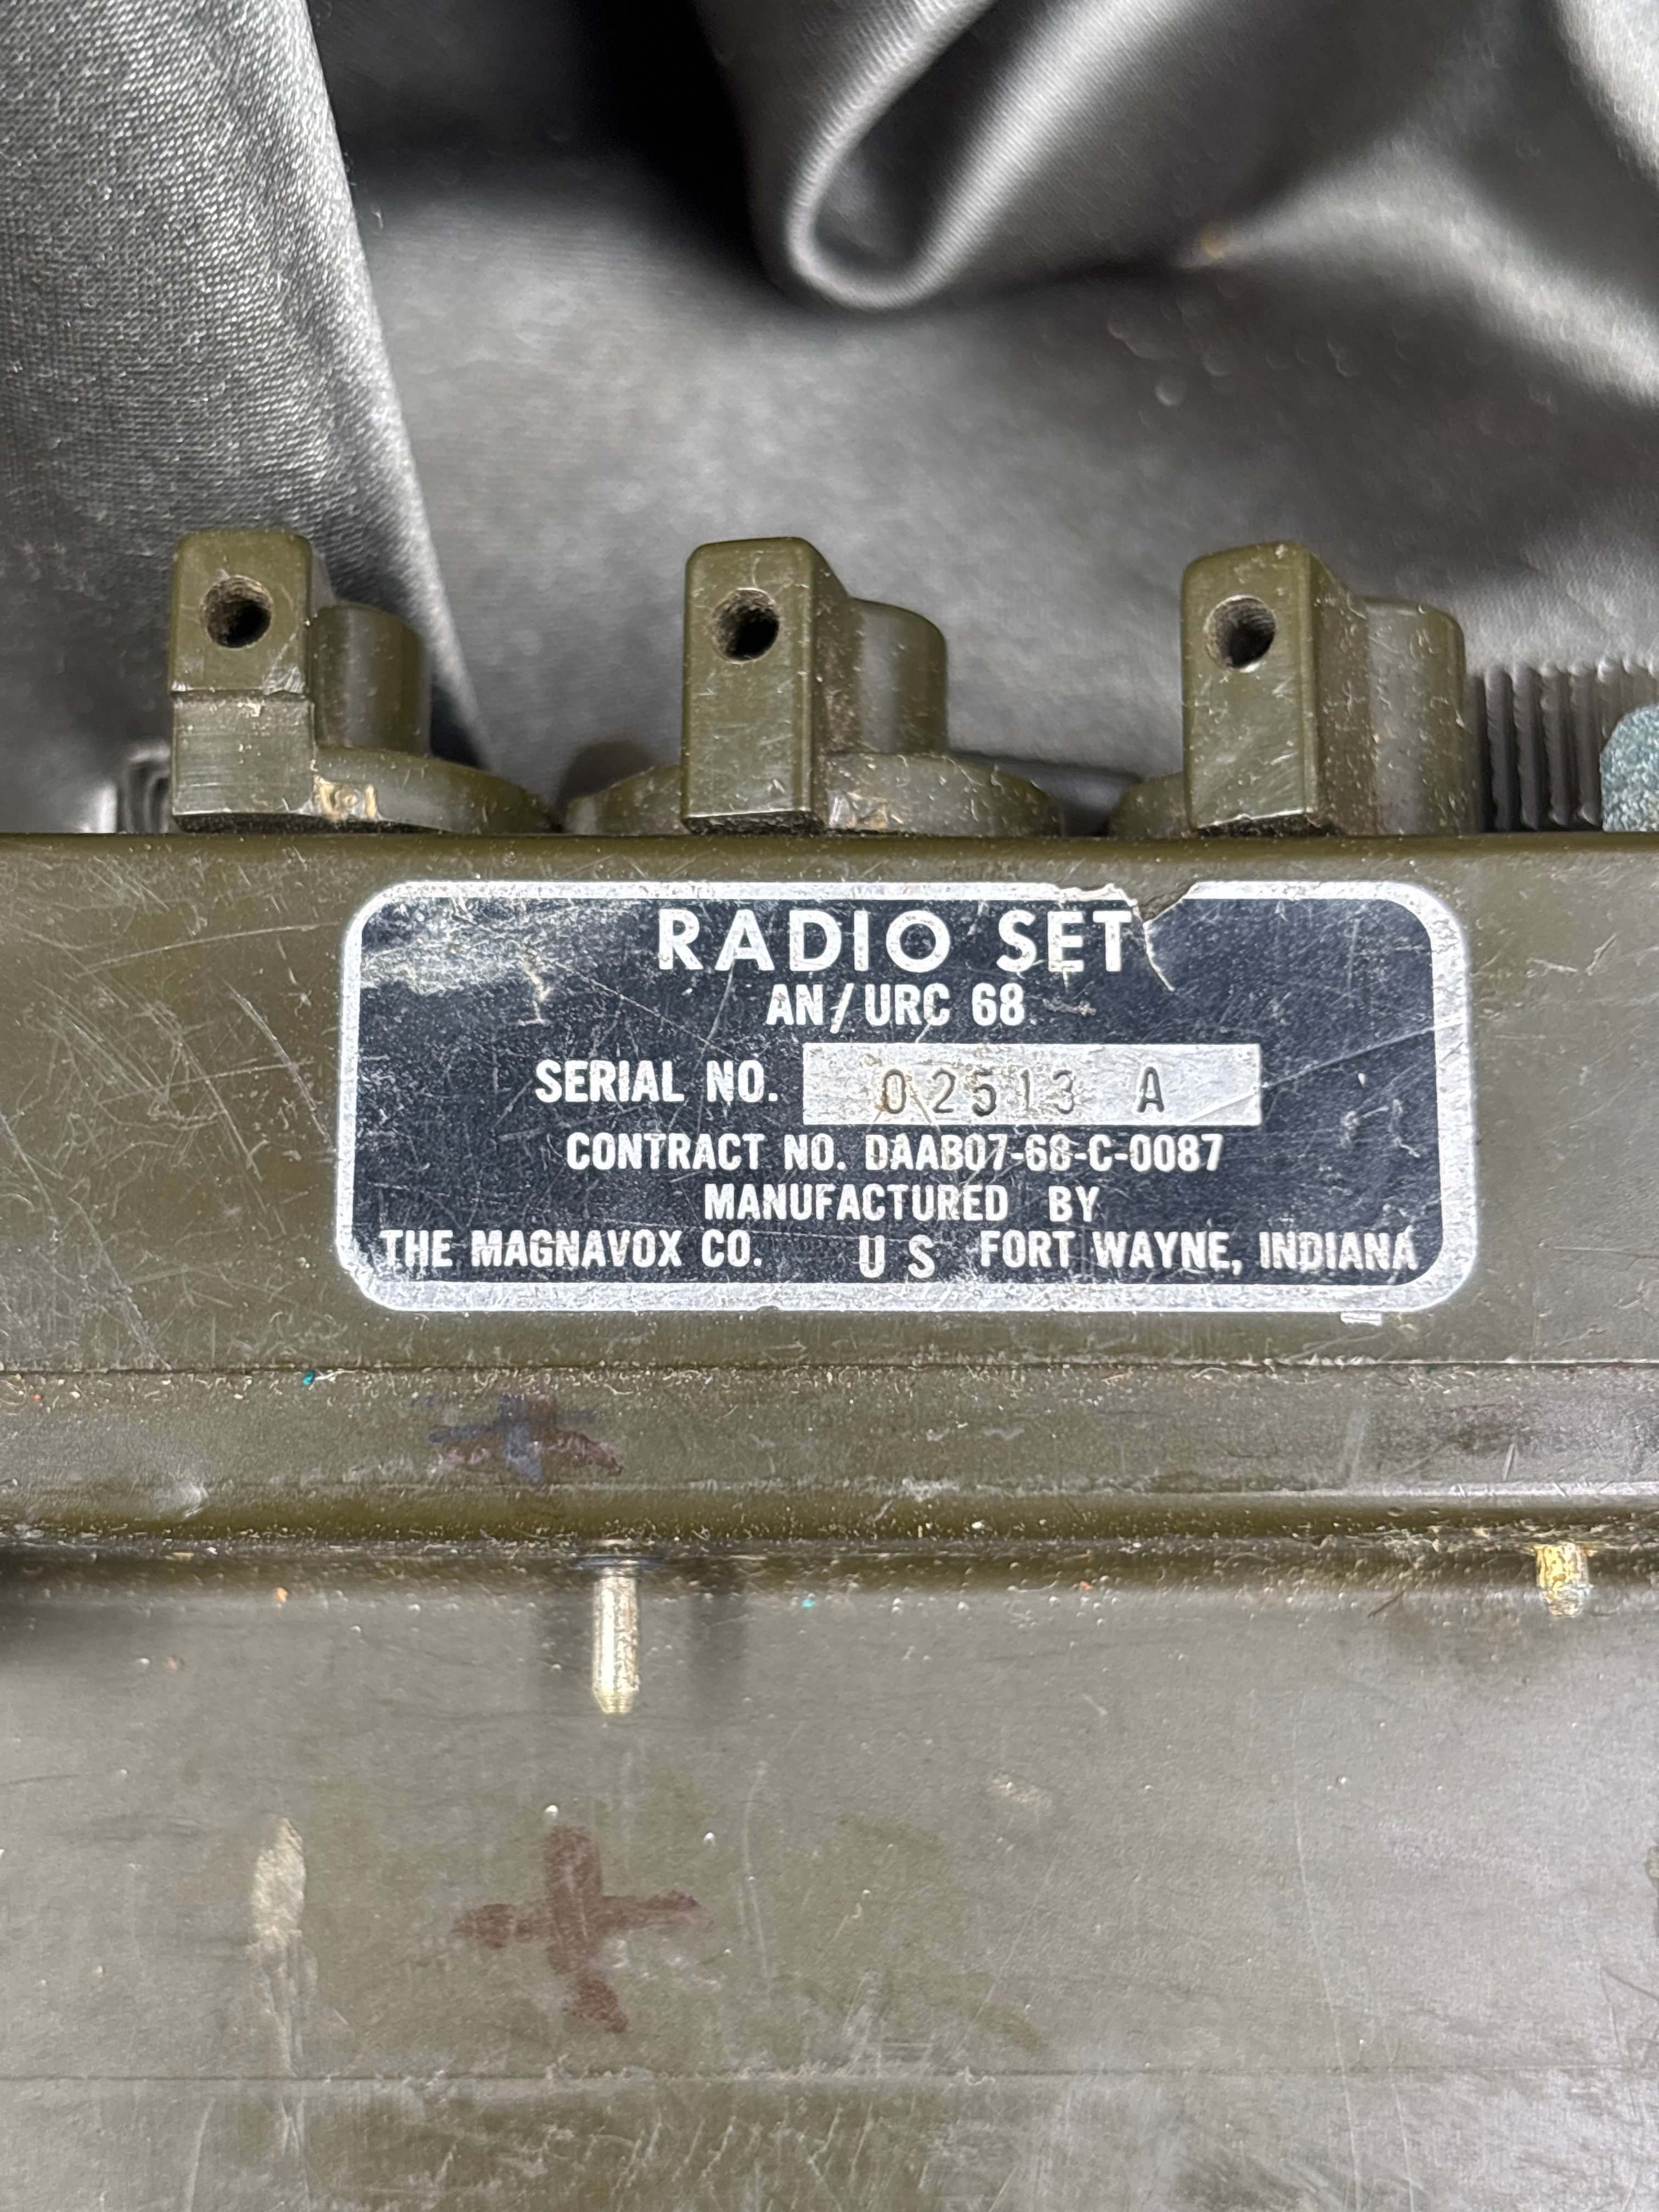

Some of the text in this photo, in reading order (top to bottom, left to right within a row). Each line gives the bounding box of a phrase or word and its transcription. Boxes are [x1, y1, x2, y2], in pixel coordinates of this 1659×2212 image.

[657, 909, 1132, 973] RADIO SET
[765, 982, 1025, 1034] AN/URC 68
[534, 1059, 1165, 1116] SERIAL NO. 02513 A
[566, 1132, 1223, 1172] CONTRACT NO. DAAB07-68-C-0087
[703, 1183, 1099, 1223] MANUFACTURED BY
[379, 1229, 453, 1268] THE
[470, 1229, 682, 1268] MAGNAVOX
[701, 1230, 762, 1268] CO.
[859, 1234, 885, 1278] U
[908, 1234, 935, 1279] S
[979, 1230, 1075, 1269] FORT
[1260, 1230, 1418, 1272] INDIANA
